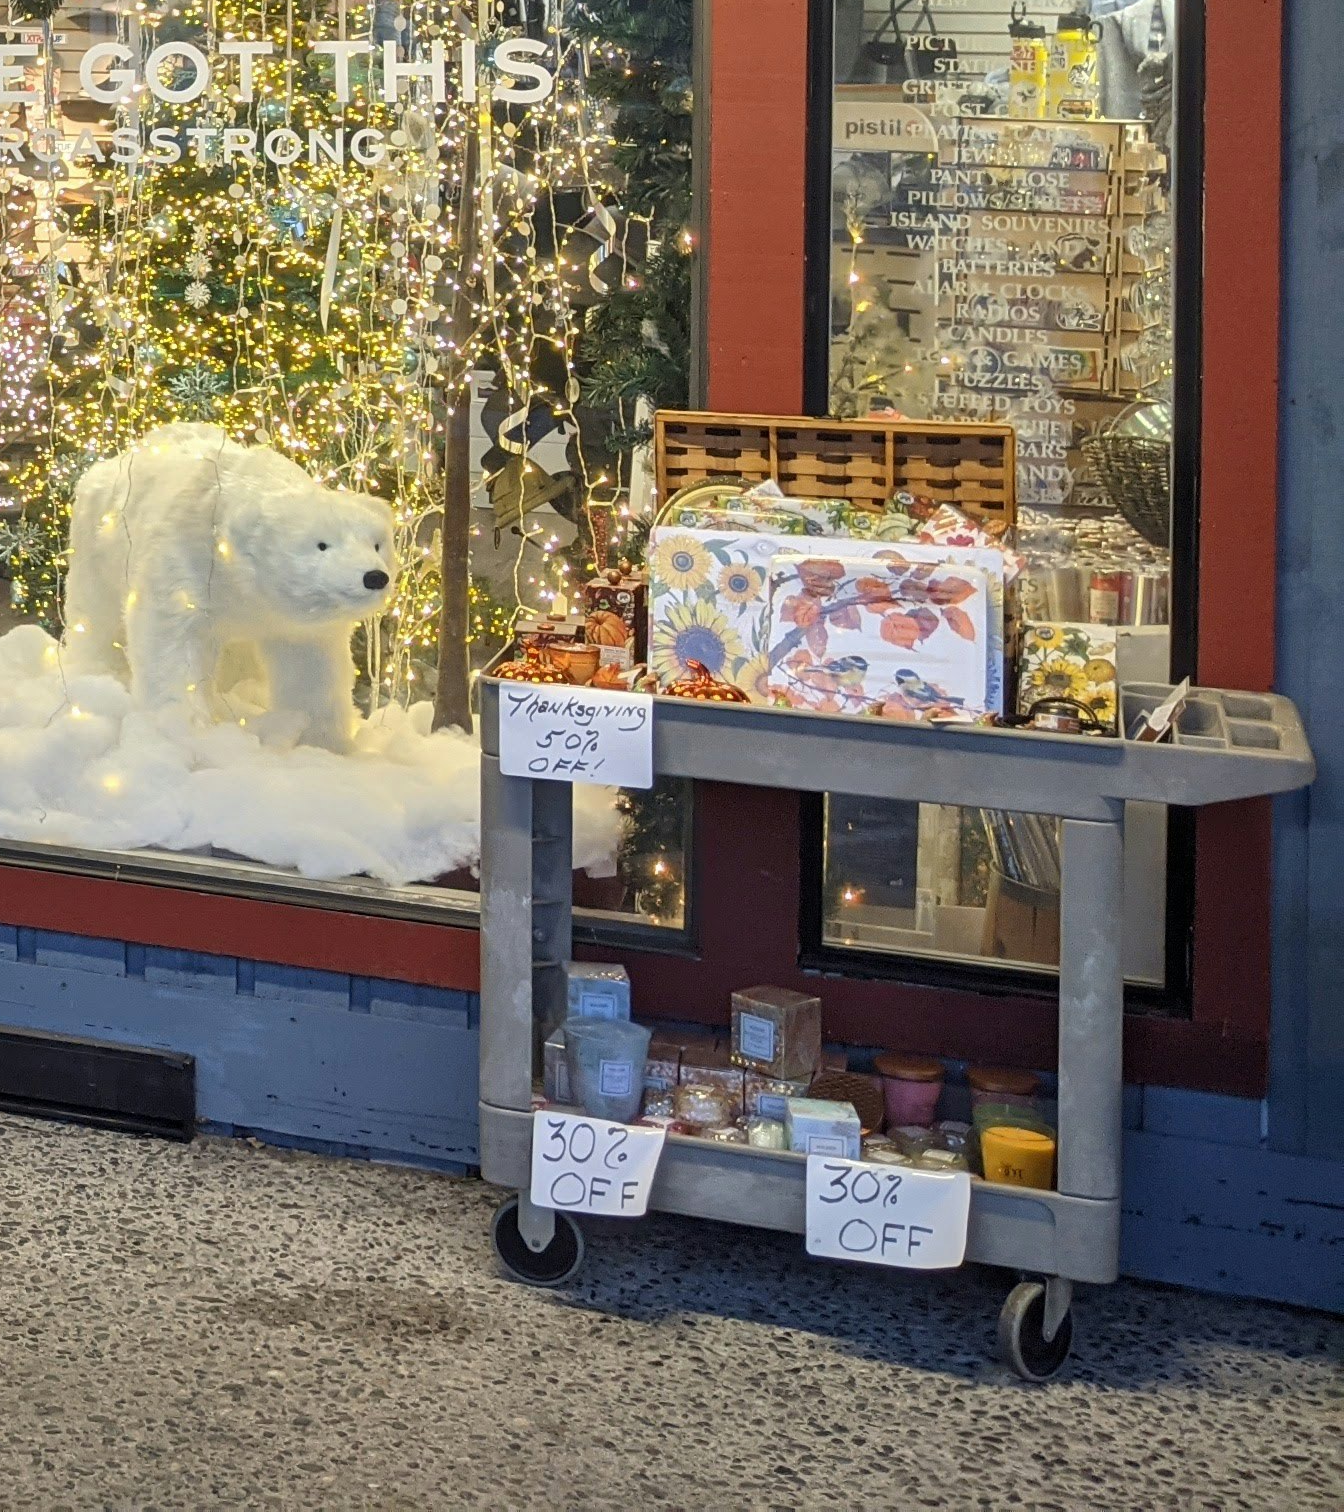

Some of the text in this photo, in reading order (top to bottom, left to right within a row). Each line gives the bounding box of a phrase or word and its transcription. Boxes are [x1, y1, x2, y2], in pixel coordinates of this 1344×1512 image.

[79, 40, 274, 105] GOT
[314, 38, 554, 105] THIS
[930, 103, 986, 117] POST
[845, 118, 902, 138] pistil
[930, 169, 1069, 186] PANTY HOSE
[890, 212, 1110, 233] ISLAND SOUVENIRS
[906, 234, 1080, 255] WATCHES AND
[941, 259, 1055, 278] BATTERIES
[913, 281, 1085, 300] ALARM CLOCKS
[956, 304, 1040, 322] RADIOS
[948, 326, 1048, 344] CANDLES
[1003, 352, 1082, 368] GAMES
[950, 373, 1043, 389] PUZZLES
[1023, 397, 1075, 414] TOYS
[536, 730, 599, 756] 50%
[528, 757, 605, 777] OFF!
[541, 1119, 629, 1170] 30%
[550, 1172, 640, 1210] OFF
[818, 1165, 903, 1206] 30%
[838, 1218, 934, 1258] OFF
